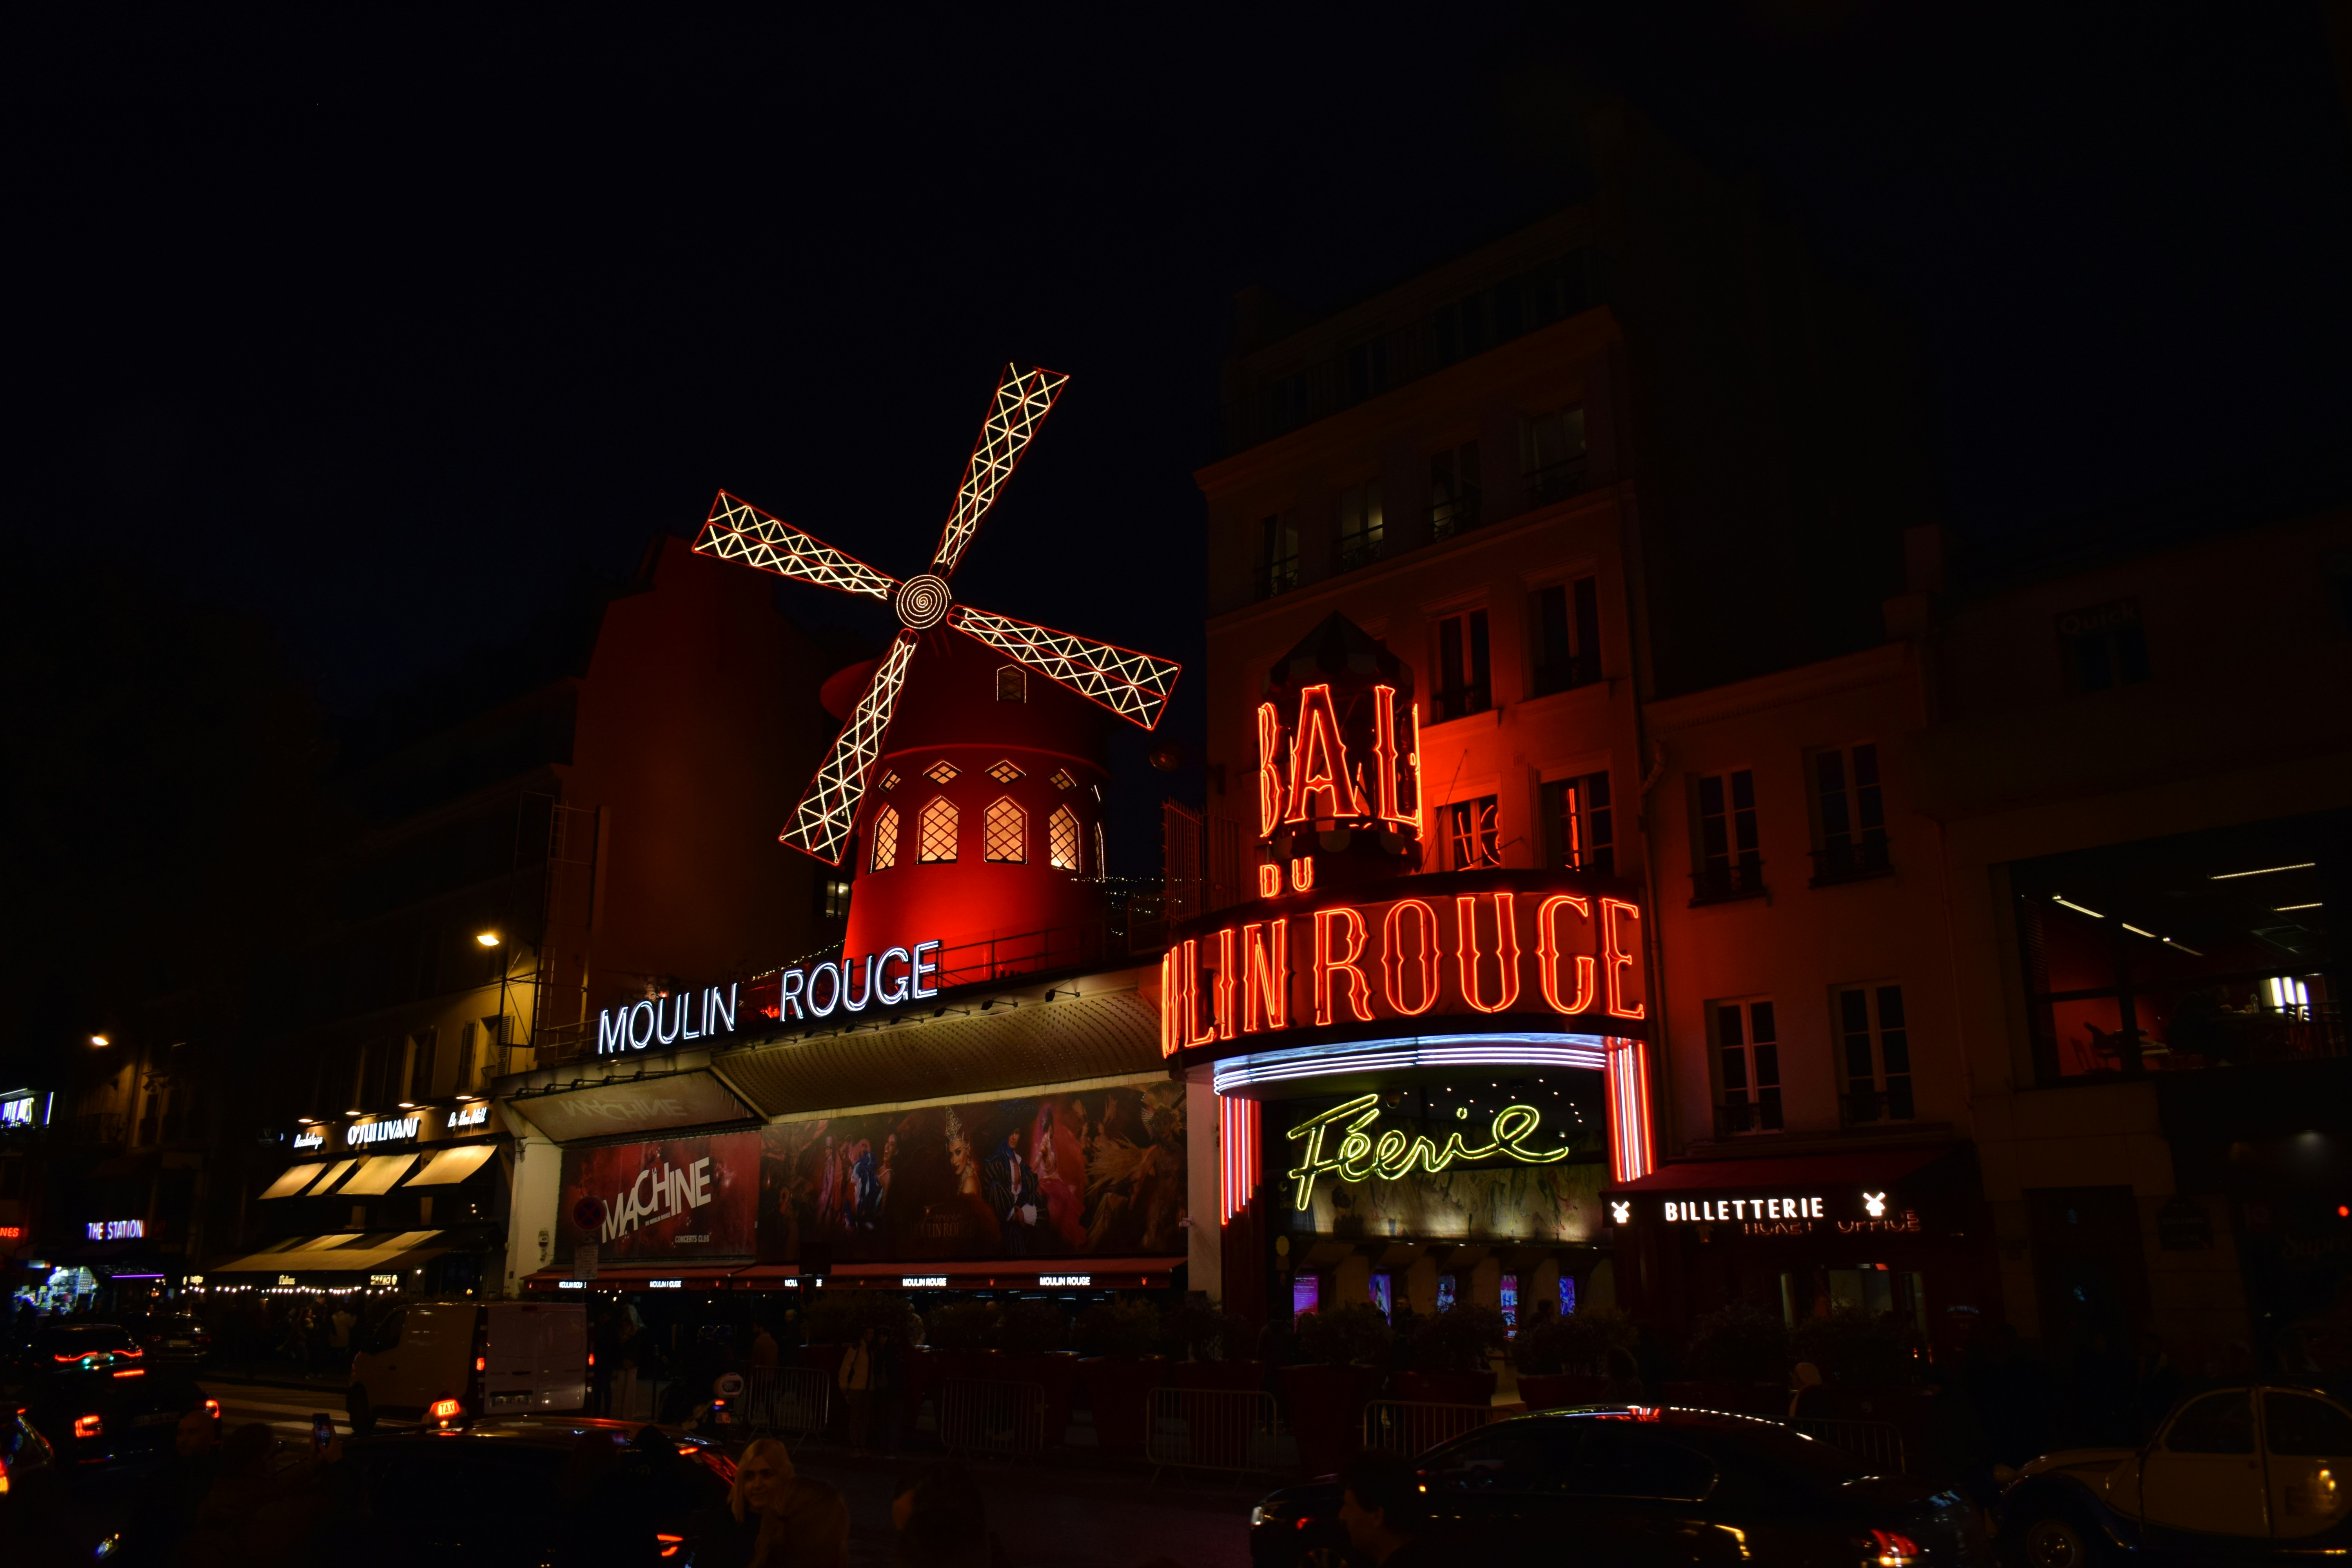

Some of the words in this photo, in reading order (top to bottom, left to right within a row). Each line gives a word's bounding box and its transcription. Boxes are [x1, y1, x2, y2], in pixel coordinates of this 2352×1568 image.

[2060, 601, 2137, 636] Quick
[1258, 684, 1419, 838] BAL
[1259, 857, 1314, 898] DU
[1161, 918, 1289, 1059] ULIN
[1312, 892, 1646, 1028] ROUGE
[597, 982, 739, 1056] MOULIN
[780, 939, 942, 1022] ROUGE
[470, 1107, 487, 1124] Mill
[1286, 1093, 1570, 1212] Féerie
[602, 1156, 712, 1244] MACHINE
[1664, 1196, 1824, 1222] BILLETTERIE
[88, 1221, 104, 1240] THE
[107, 1219, 144, 1240] STATION
[909, 1221, 942, 1238] MOULIN
[943, 1220, 973, 1237] ROUGE
[2162, 1216, 2205, 1225] BOULEVARD
[675, 1235, 697, 1243] CONCERTS
[698, 1234, 710, 1243] CLUB
[902, 1278, 925, 1287] MOULIN
[926, 1278, 947, 1286] ROUGE
[1040, 1276, 1065, 1286] MOULIN
[1066, 1276, 1091, 1286] ROUGE
[440, 1402, 456, 1414] TAXI
